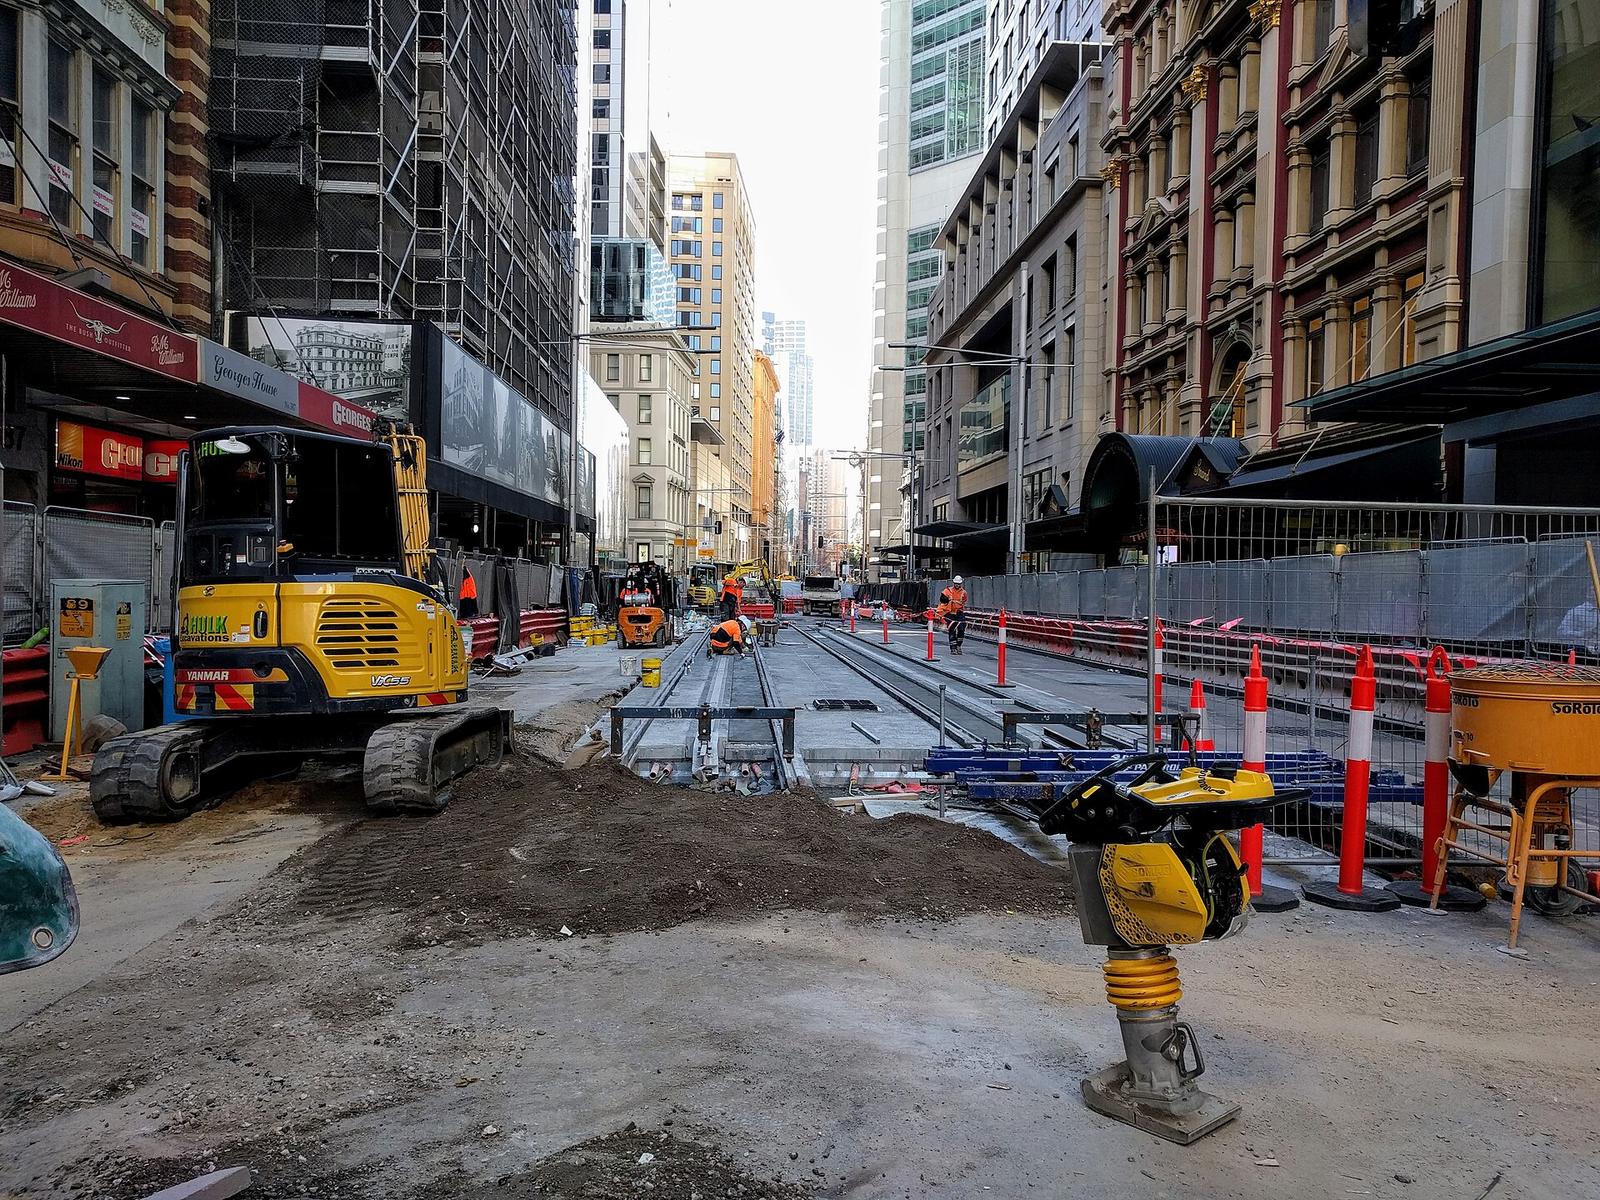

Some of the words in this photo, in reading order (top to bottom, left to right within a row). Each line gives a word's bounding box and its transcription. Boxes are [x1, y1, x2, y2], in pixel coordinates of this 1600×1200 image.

[213, 355, 251, 389] Georges
[251, 371, 279, 397] House
[332, 400, 371, 433] GEORGES
[59, 452, 83, 469] Nikon
[66, 599, 89, 610] 89
[190, 615, 228, 635] HULK
[180, 634, 229, 642] xcavations
[187, 671, 229, 681] YANMAR
